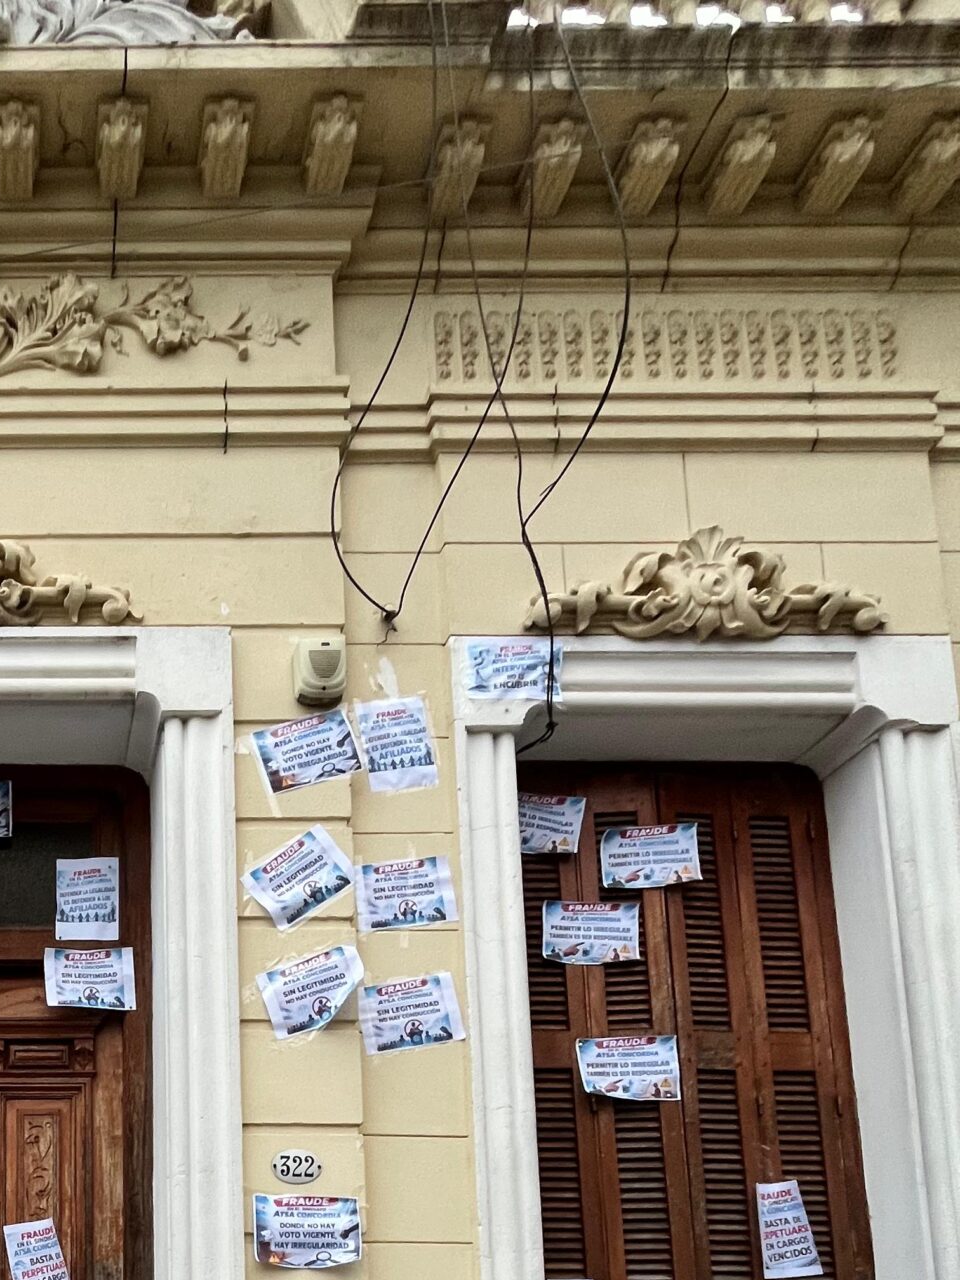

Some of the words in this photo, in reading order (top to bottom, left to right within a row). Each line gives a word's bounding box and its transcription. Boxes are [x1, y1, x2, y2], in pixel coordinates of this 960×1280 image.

[376, 709, 406, 718] FRAUDE
[277, 718, 321, 736] FRAUDE
[379, 747, 422, 760] AFILIADOS
[626, 826, 668, 838] FRAUDE
[265, 841, 302, 872] FRAUDE
[283, 855, 324, 886] LEGITIMIDAD
[378, 861, 420, 873] FRAUDE
[69, 903, 108, 912] AFILIADOS
[568, 903, 611, 912] FRAUDE
[69, 952, 106, 961] FRAUDE
[284, 954, 327, 976] FRAUDE
[297, 973, 346, 993] LEGITIMIDAD
[381, 980, 423, 995] FRAUDE
[390, 1000, 439, 1014] LEGITIMIDAD
[602, 1038, 647, 1048] FRAUDE
[280, 1155, 315, 1177] 322
[764, 1218, 790, 1228] BASTA
[776, 1236, 809, 1248] CARGOS
[768, 1246, 812, 1262] VENCIDOS
